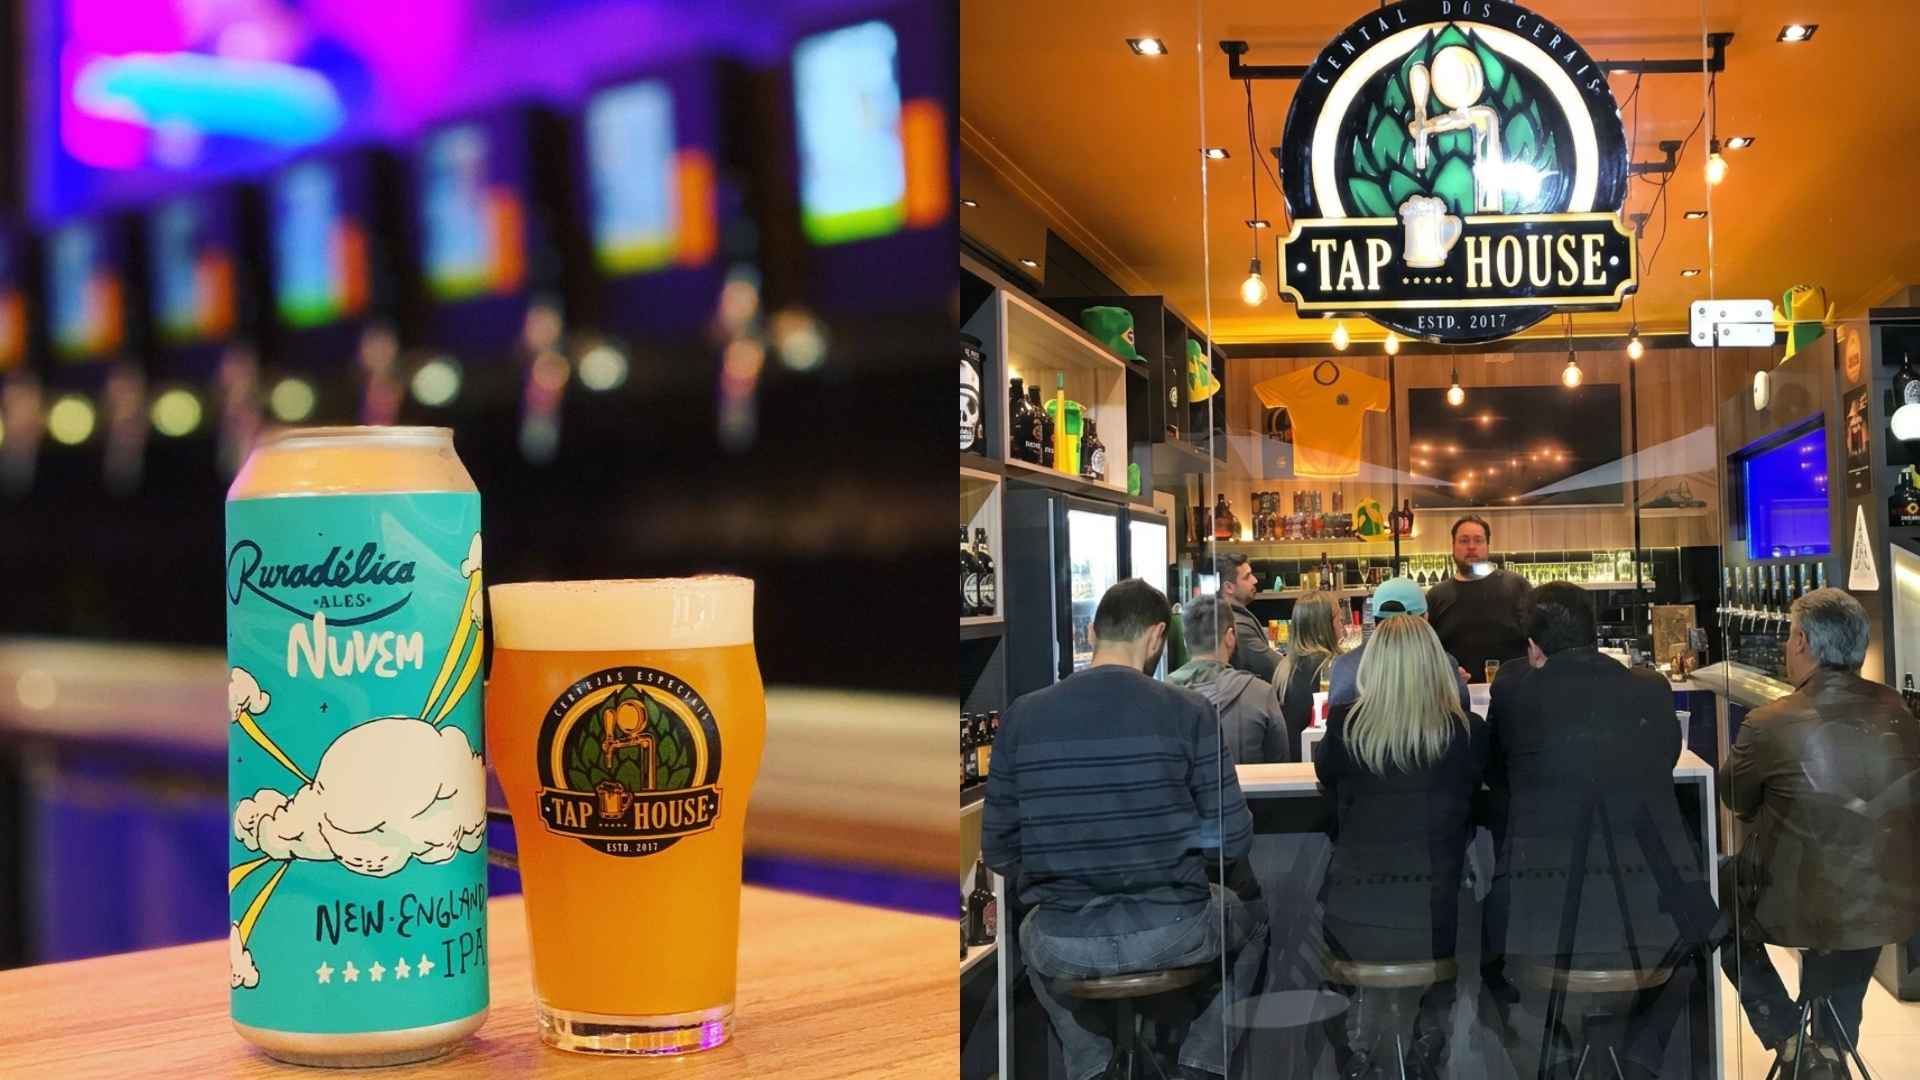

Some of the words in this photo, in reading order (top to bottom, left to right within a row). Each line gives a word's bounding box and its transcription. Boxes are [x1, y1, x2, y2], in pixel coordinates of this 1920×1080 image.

[1316, 9, 1407, 84] CENTAL
[1442, 1, 1491, 17] DOS
[1516, 15, 1600, 90] CERAIS
[1312, 238, 1392, 291] TAP
[1464, 233, 1607, 289] HOUSE
[1418, 315, 1462, 330] ESTD.
[1470, 314, 1507, 328] 2017
[228, 540, 416, 605] Ruradélica
[319, 593, 366, 609] ALES
[287, 611, 424, 679] NUVEM
[637, 671, 710, 720] ESPECIAIS
[551, 798, 593, 828] TAP
[635, 795, 709, 830] HOUSE
[636, 842, 658, 852] 2017
[441, 927, 486, 978] IPA
